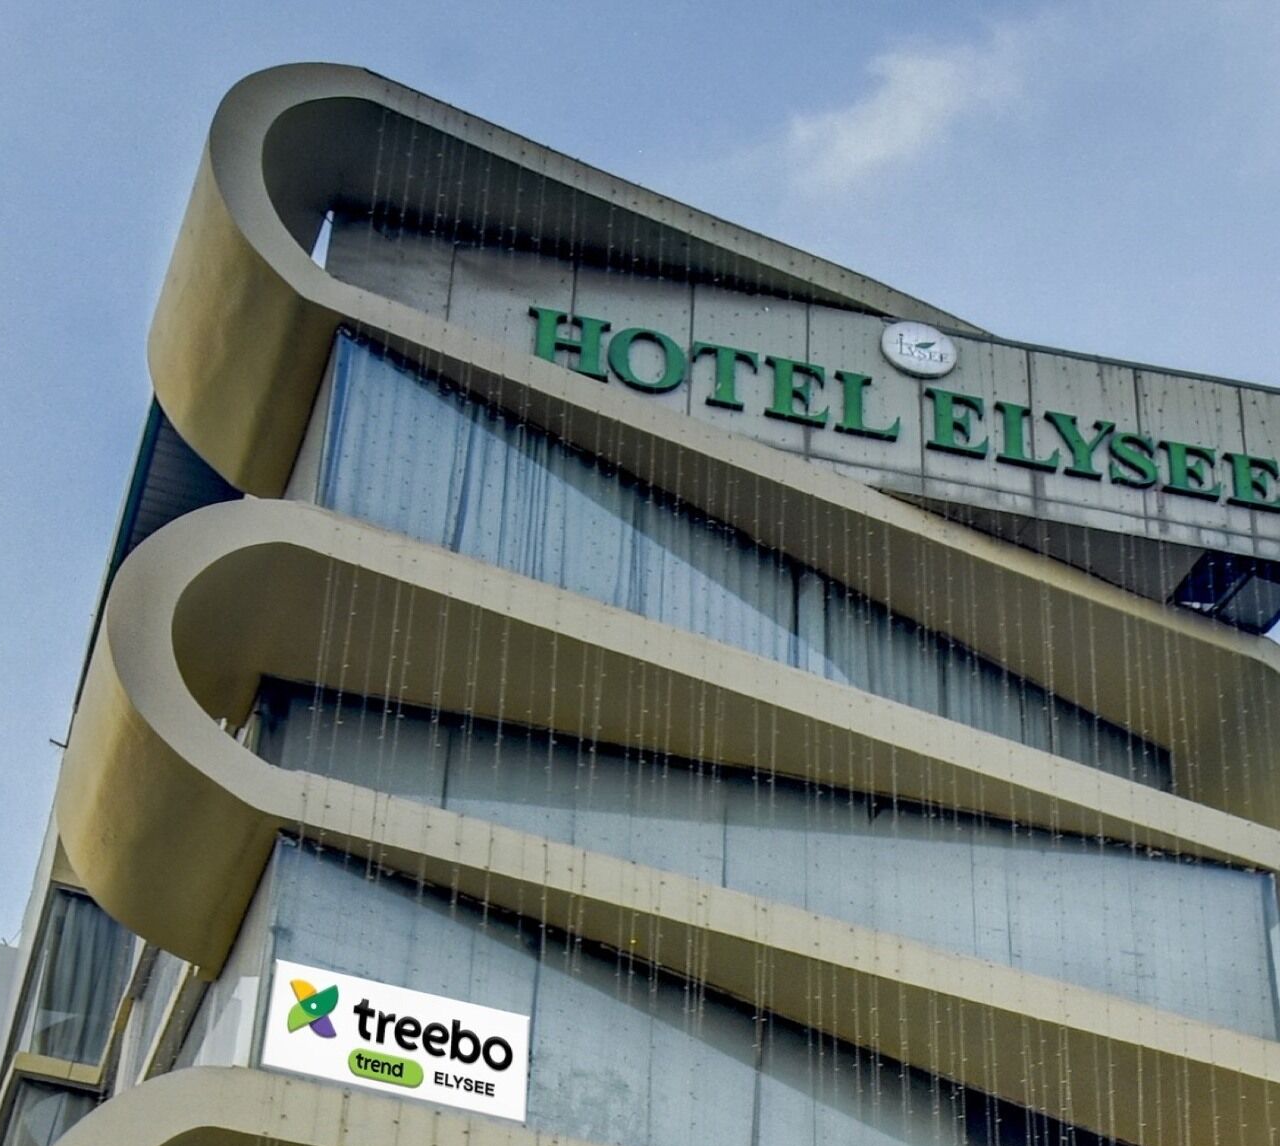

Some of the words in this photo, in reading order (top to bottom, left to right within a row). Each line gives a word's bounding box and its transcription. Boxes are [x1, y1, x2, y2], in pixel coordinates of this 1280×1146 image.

[528, 306, 900, 443] HOTEL
[353, 998, 513, 1071] treebo
[355, 1053, 404, 1078] trend
[433, 1072, 496, 1097] ELYSEE
